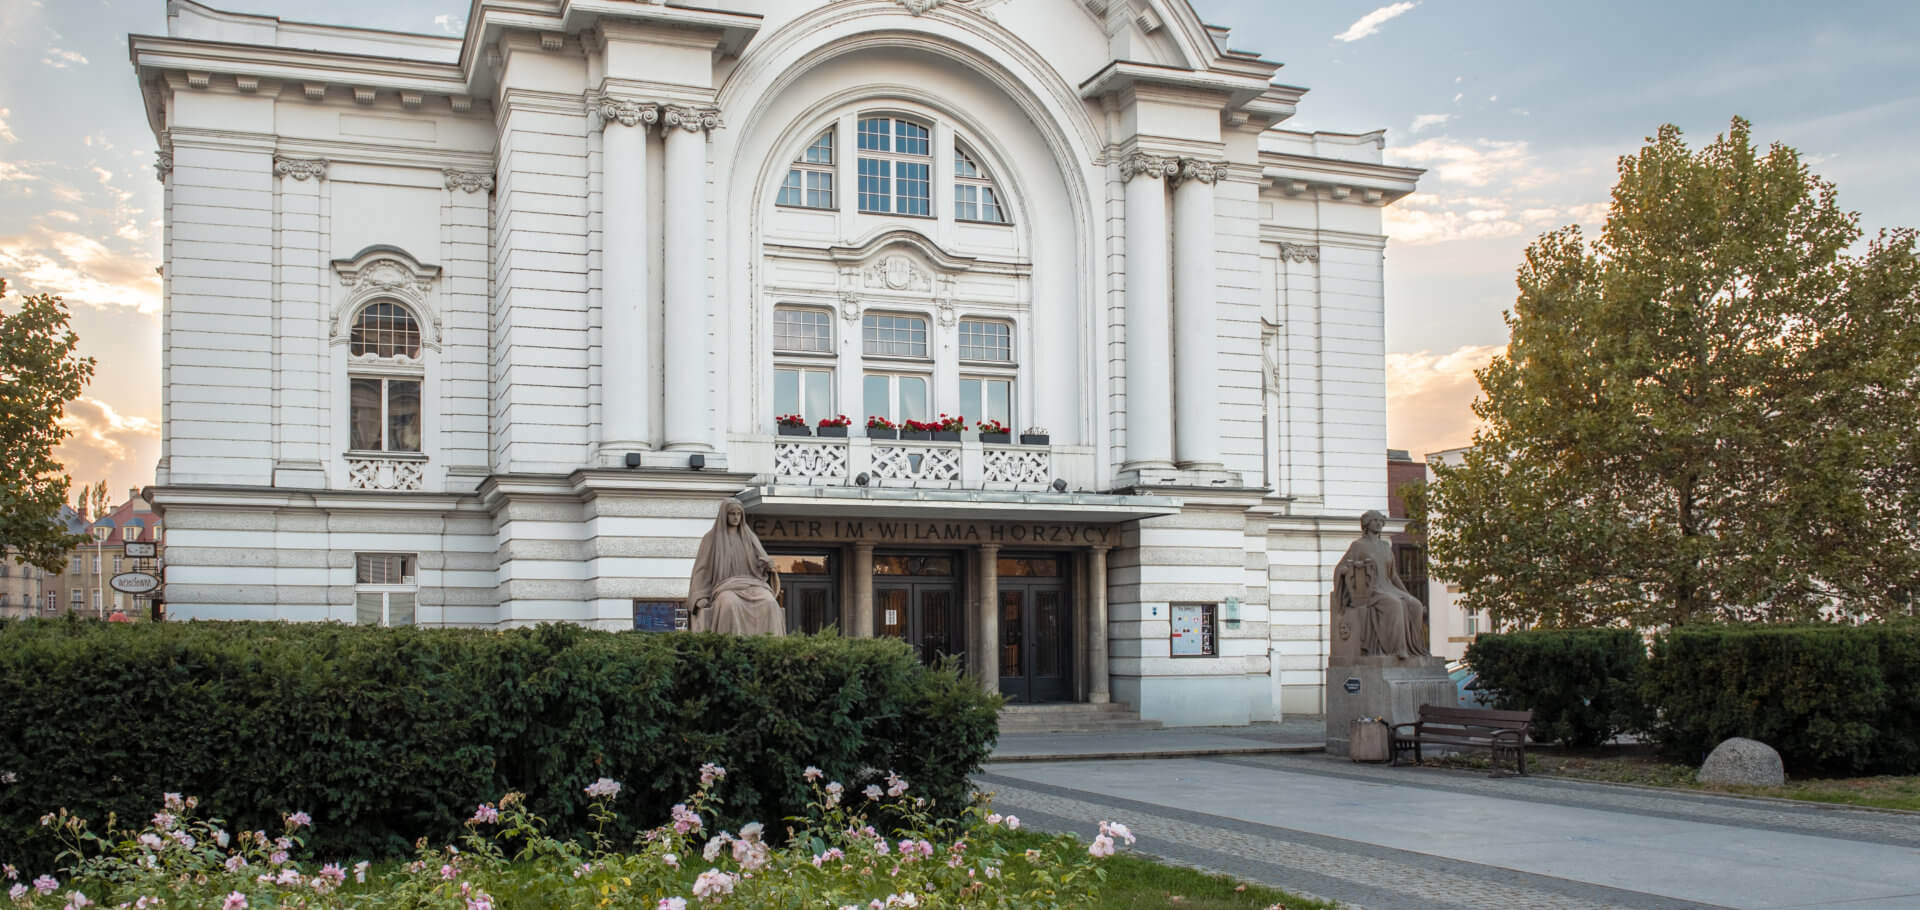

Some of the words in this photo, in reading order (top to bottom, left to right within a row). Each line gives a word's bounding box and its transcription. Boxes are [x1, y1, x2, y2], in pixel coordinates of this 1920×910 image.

[752, 520, 824, 538] EATR
[878, 521, 981, 540] WILAMA
[990, 524, 1112, 543] HORZYCY
